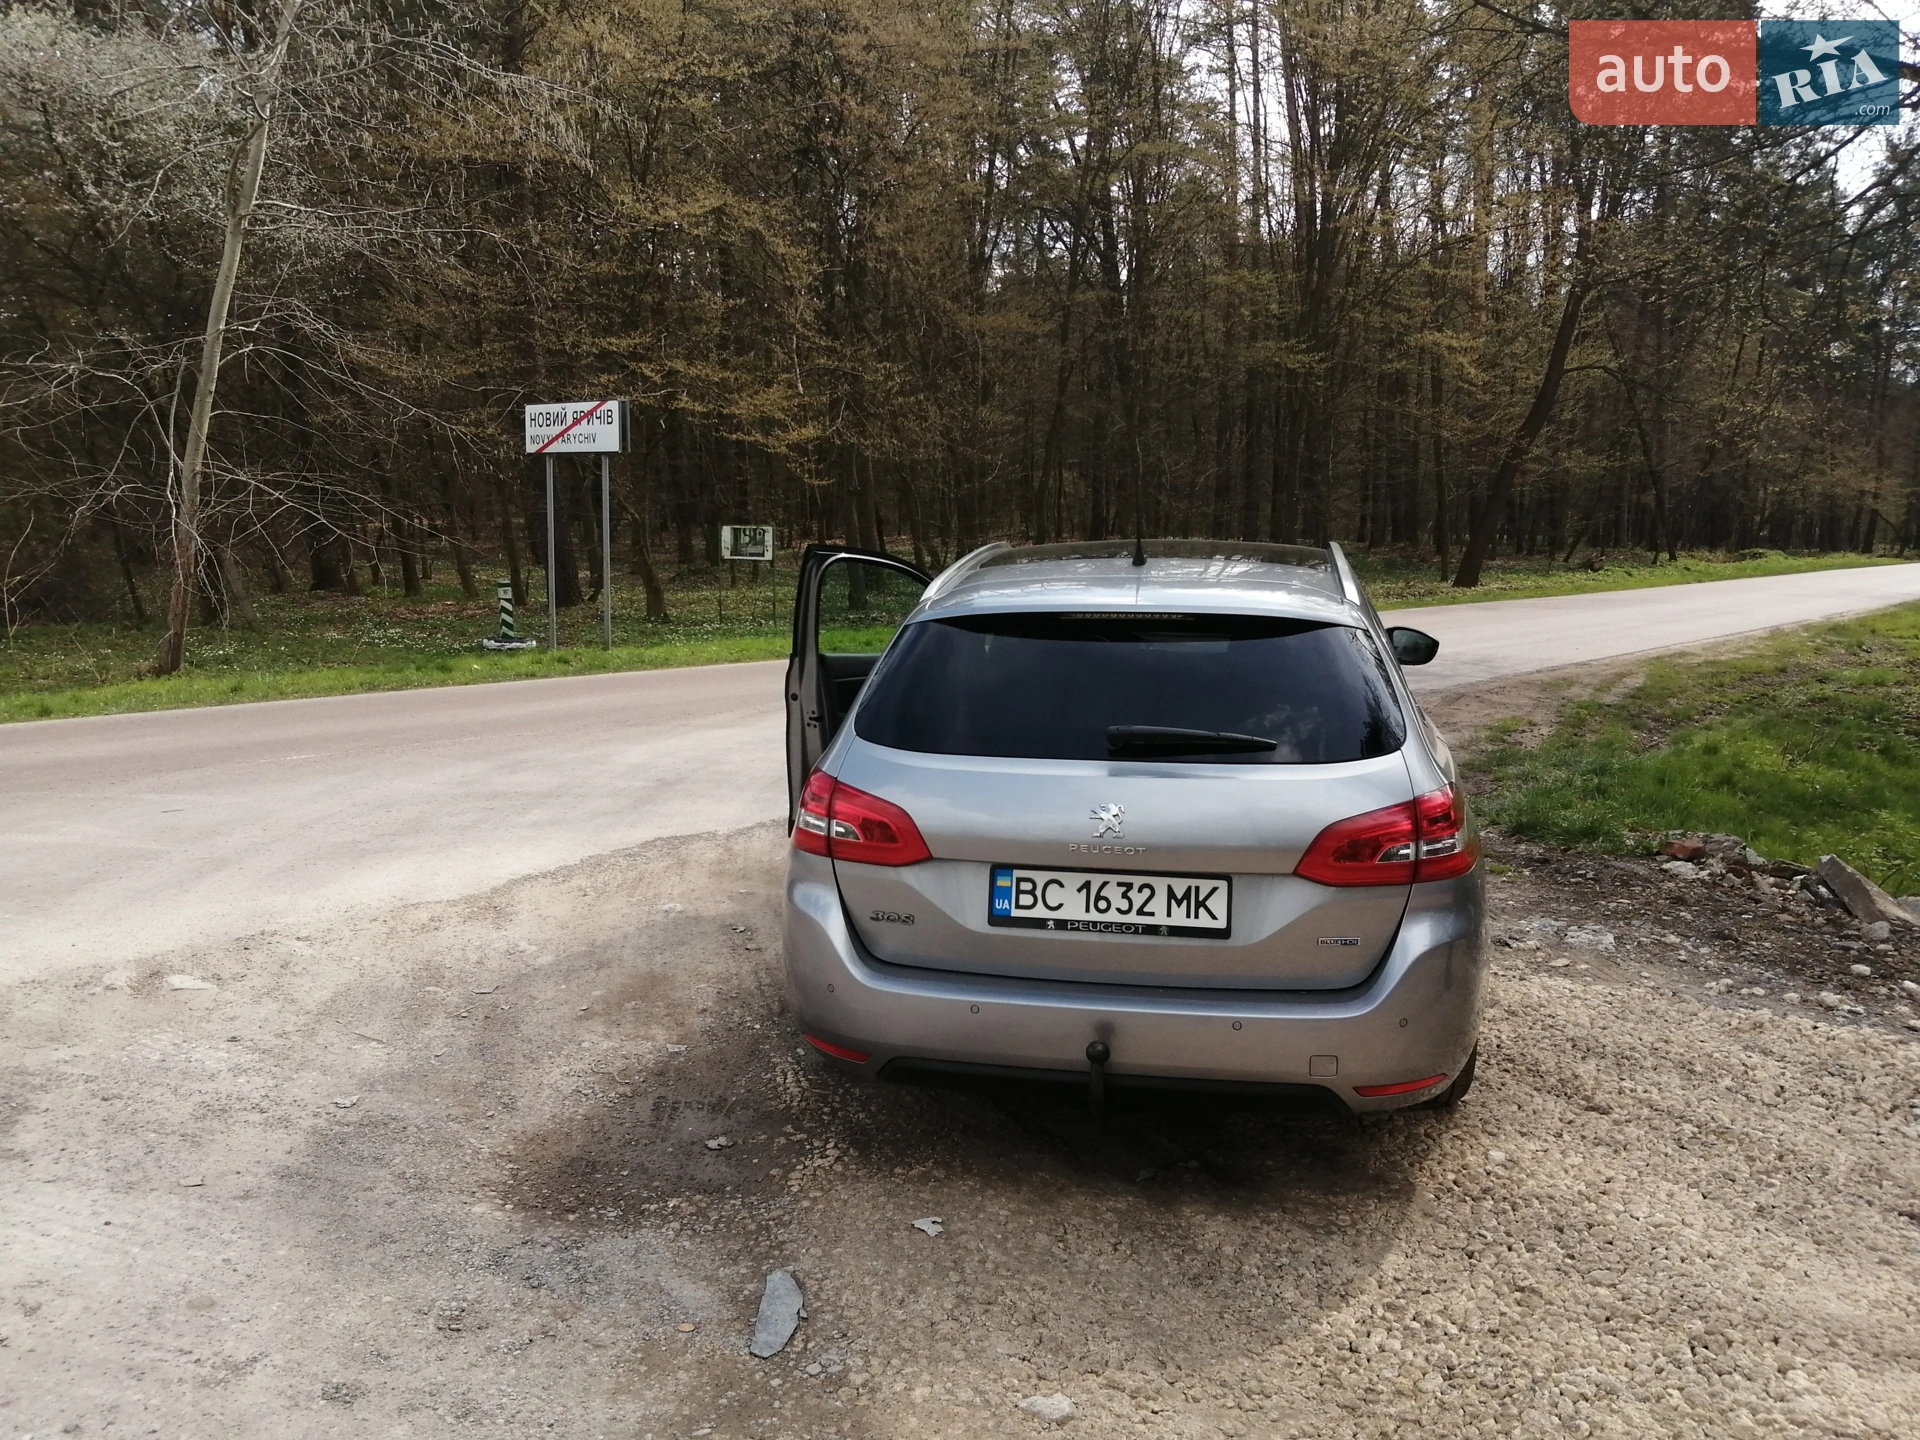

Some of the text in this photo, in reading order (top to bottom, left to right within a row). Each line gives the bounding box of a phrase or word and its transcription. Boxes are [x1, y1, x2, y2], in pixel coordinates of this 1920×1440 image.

[529, 406, 567, 428] НОВИЙ
[1069, 843, 1146, 855] PEUGEOT
[995, 898, 1010, 910] UA
[1014, 876, 1220, 920] BC 1632 MK
[870, 909, 915, 925] 308
[1067, 920, 1146, 934] PEUGEOT
